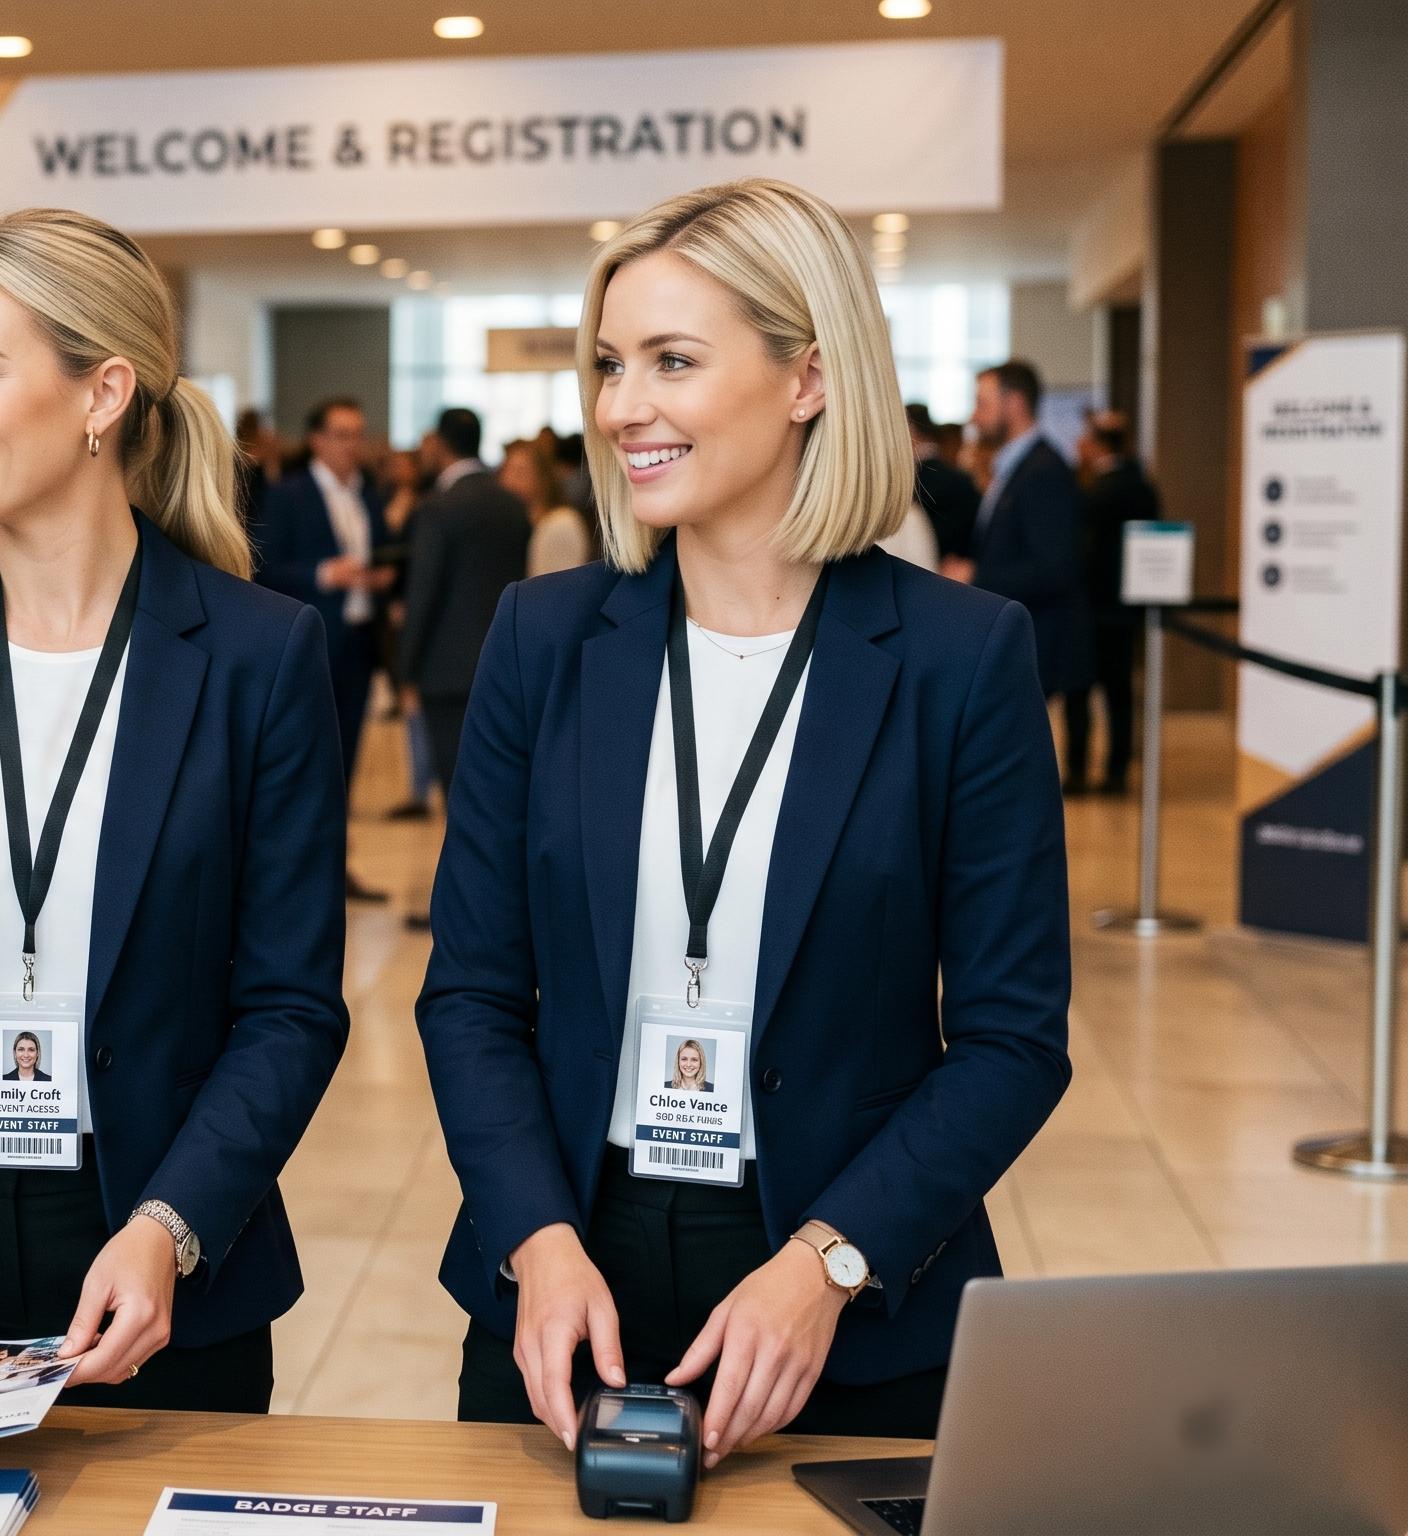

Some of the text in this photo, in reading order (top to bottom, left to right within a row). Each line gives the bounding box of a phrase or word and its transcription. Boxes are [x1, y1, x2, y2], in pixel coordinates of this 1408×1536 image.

[34, 106, 808, 177] WELCOME & REGISTRATION
[30, 1089, 61, 1101] Croft
[649, 1095, 728, 1113] Chloe Vance
[27, 1121, 59, 1131] STAFF
[652, 1129, 723, 1144] EVENT STAFF
[234, 1500, 418, 1518] BADGE STAFF
